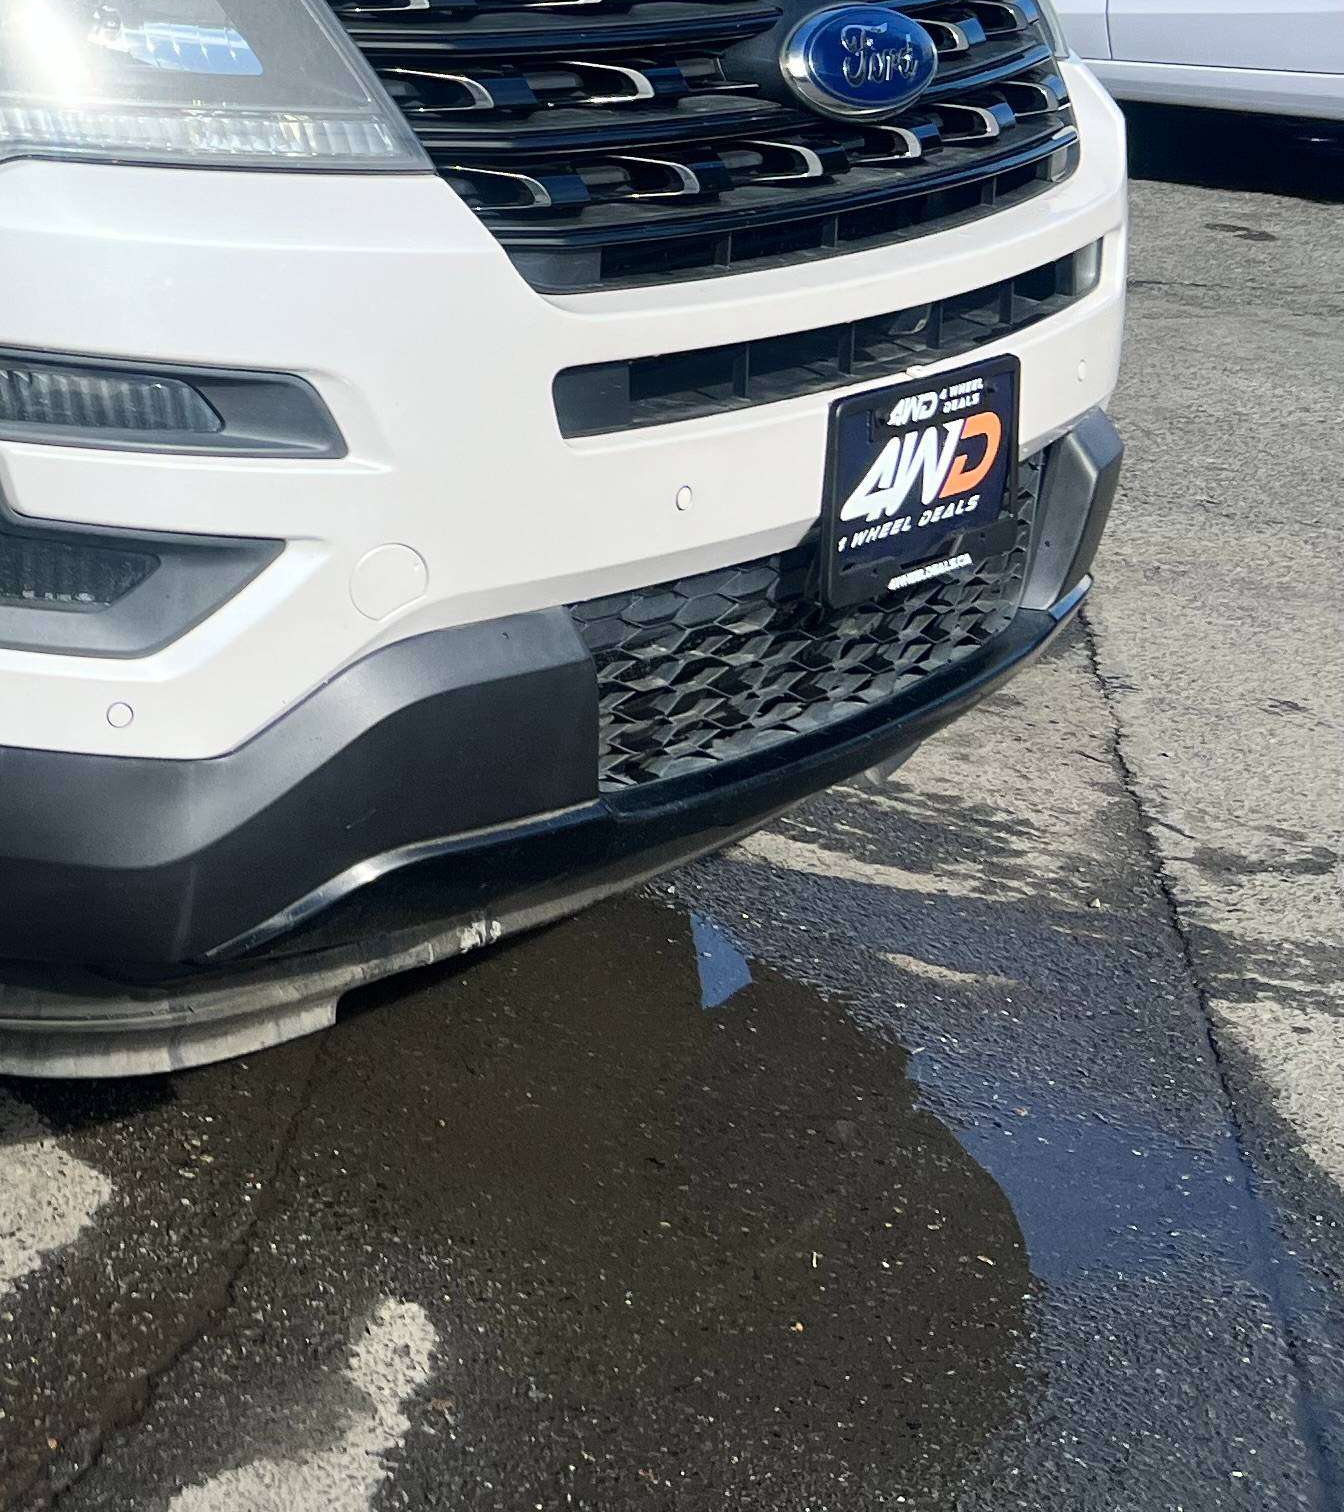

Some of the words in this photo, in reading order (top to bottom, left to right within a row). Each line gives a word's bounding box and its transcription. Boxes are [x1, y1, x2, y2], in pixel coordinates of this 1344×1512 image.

[840, 22, 919, 88] Ford
[839, 410, 1002, 523] 4WD
[850, 515, 913, 549] WHEEL
[917, 494, 981, 527] DEALS
